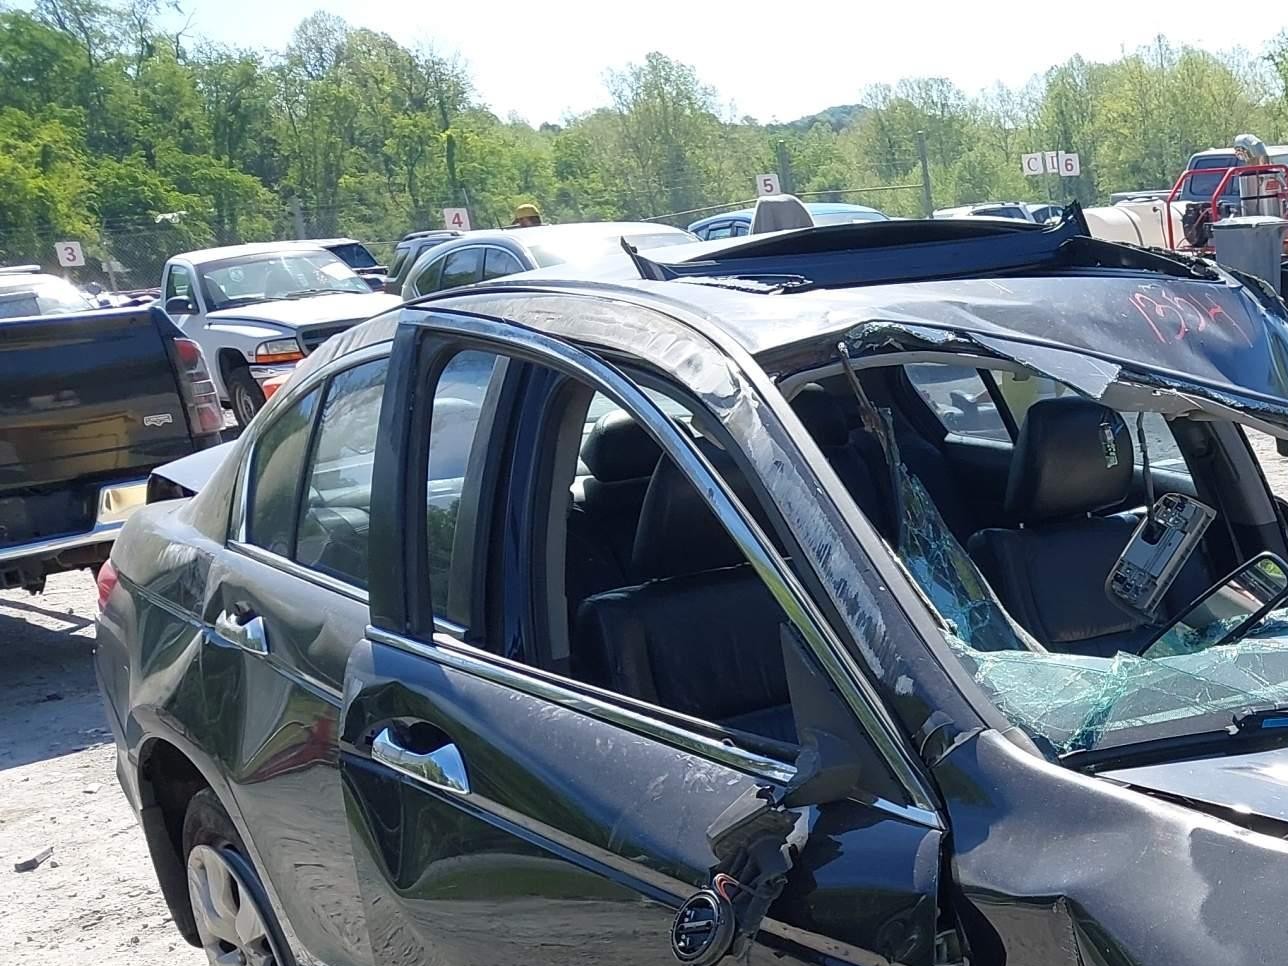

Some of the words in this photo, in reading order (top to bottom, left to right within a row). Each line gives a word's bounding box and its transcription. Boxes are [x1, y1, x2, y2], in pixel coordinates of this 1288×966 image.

[1027, 157, 1039, 172] C
[1064, 158, 1074, 172] 6
[763, 178, 774, 193] 5
[451, 212, 464, 228] 4
[63, 246, 77, 262] 3
